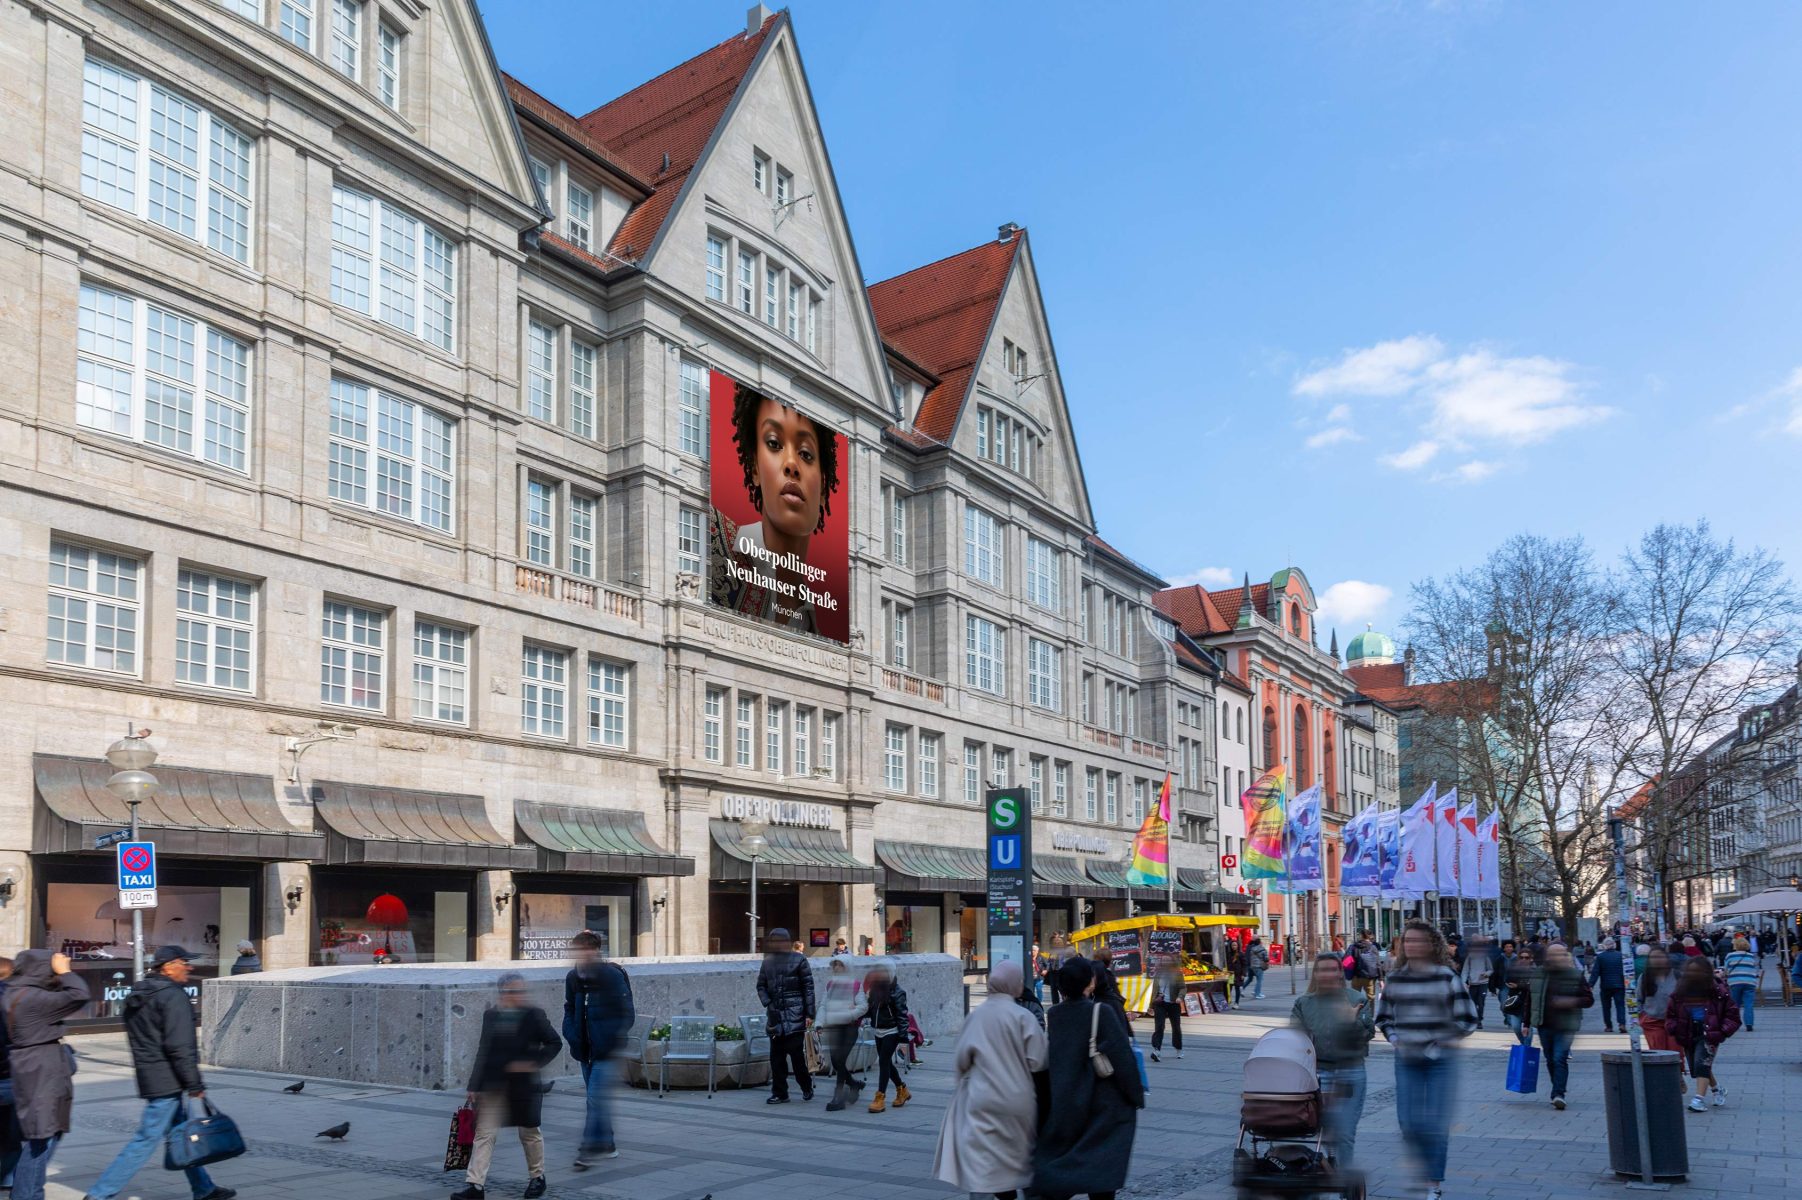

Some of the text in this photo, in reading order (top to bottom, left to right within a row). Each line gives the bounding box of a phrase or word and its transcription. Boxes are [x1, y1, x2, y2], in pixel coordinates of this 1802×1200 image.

[739, 536, 827, 582] Oberpollinger
[726, 558, 838, 611] Neuhauser Straße
[771, 602, 803, 620] München
[722, 795, 833, 827] OBERPOLLINGER
[995, 798, 1016, 827] S
[997, 839, 1015, 865] U
[123, 874, 152, 886] TAXI
[523, 941, 537, 950] 100
[540, 940, 567, 950] YEARS
